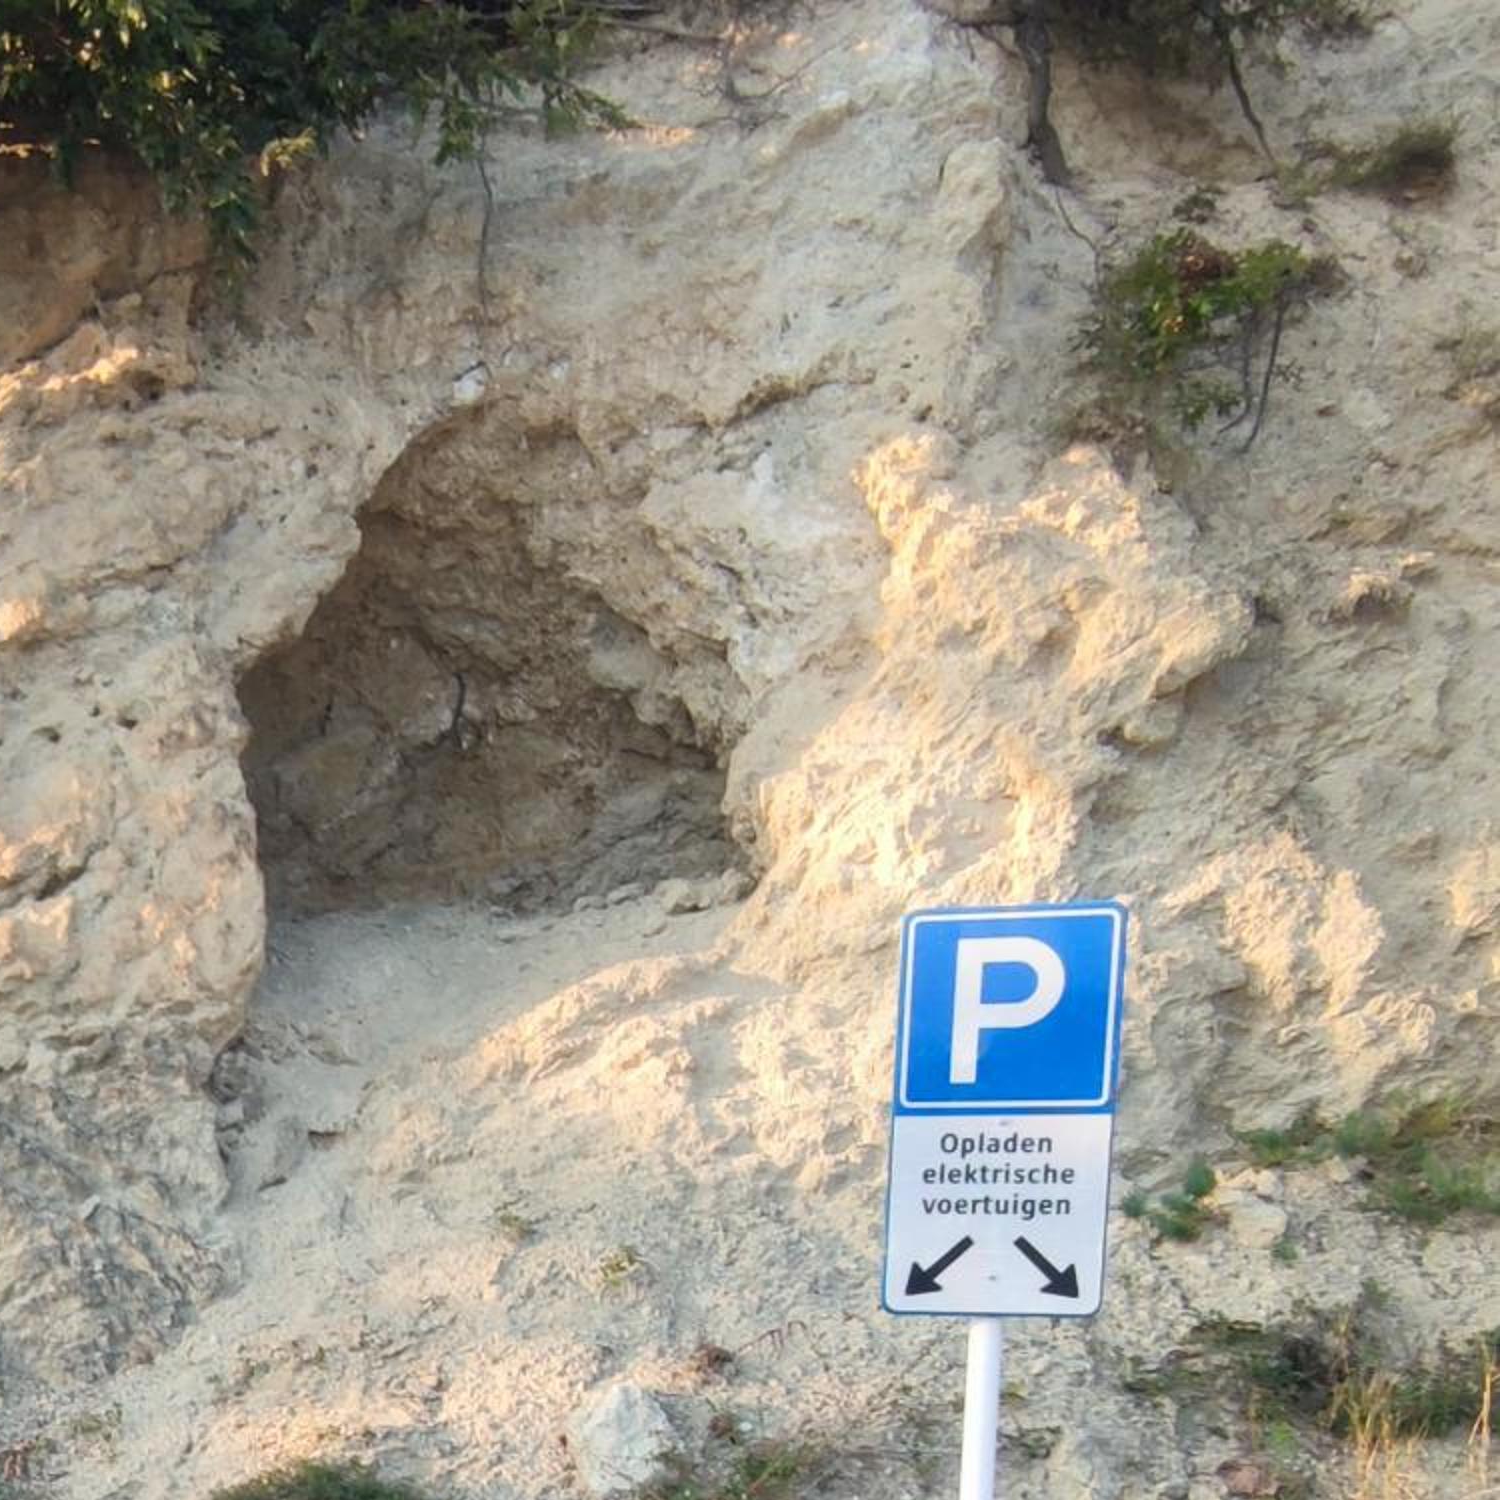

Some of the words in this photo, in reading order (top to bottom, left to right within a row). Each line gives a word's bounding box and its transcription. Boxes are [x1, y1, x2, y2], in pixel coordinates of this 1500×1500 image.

[949, 936, 1066, 1085] P
[939, 1132, 1053, 1158] Opladen
[921, 1163, 1076, 1186] elektrische
[921, 1193, 1072, 1220] voertuigen
